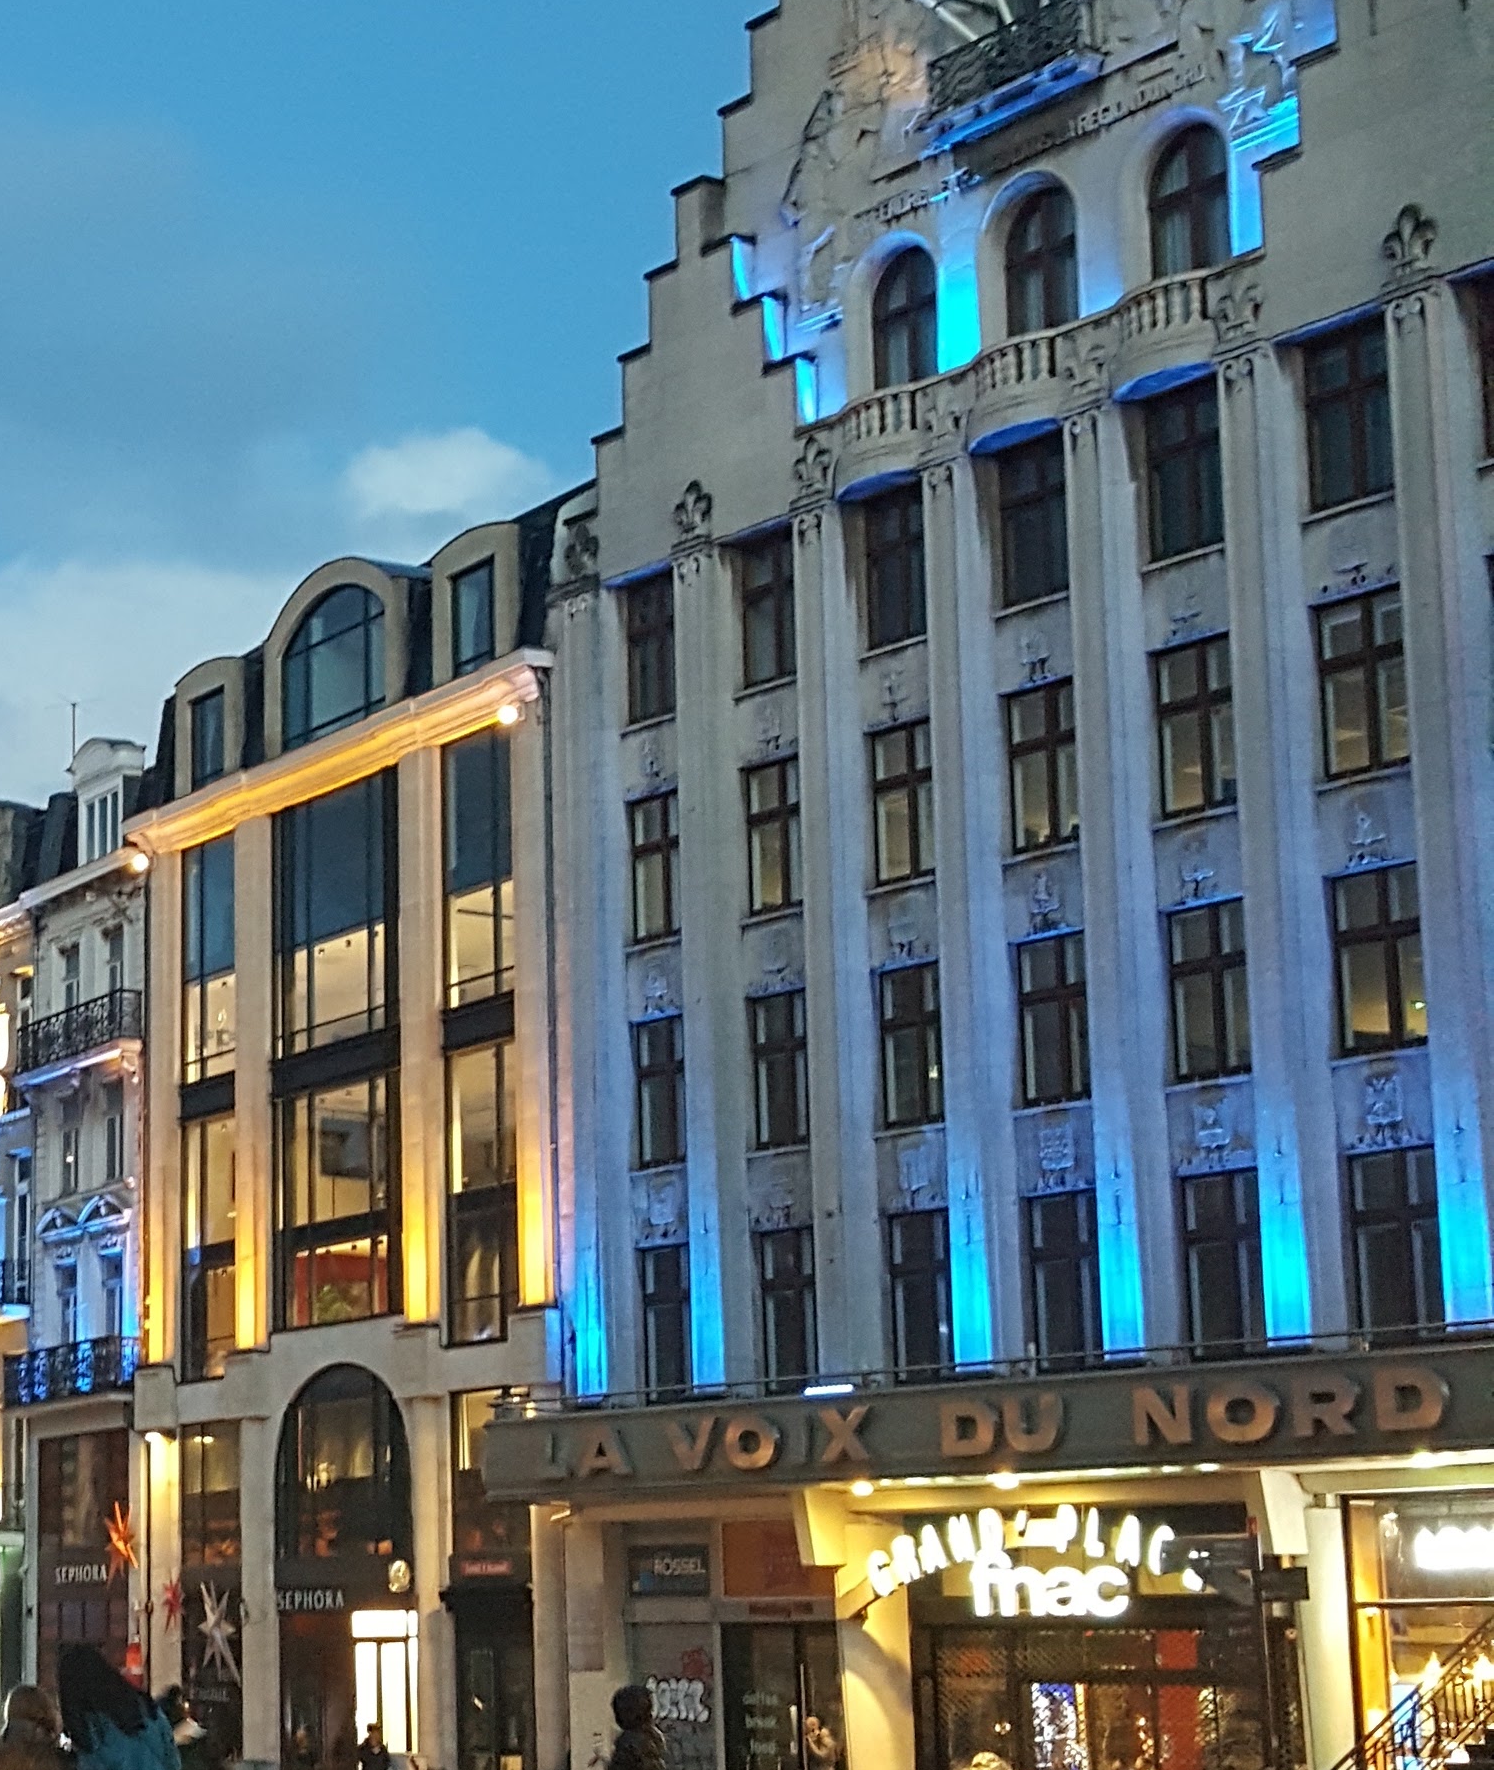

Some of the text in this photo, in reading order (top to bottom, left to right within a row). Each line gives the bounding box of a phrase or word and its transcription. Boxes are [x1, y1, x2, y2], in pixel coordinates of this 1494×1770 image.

[542, 1364, 1448, 1478] LA VOIX DU NORD
[55, 1563, 107, 1585] SEPHORA
[654, 1557, 706, 1576] ROSSEL
[969, 1549, 1131, 1618] fnac
[276, 1589, 345, 1610] SEPHORA
